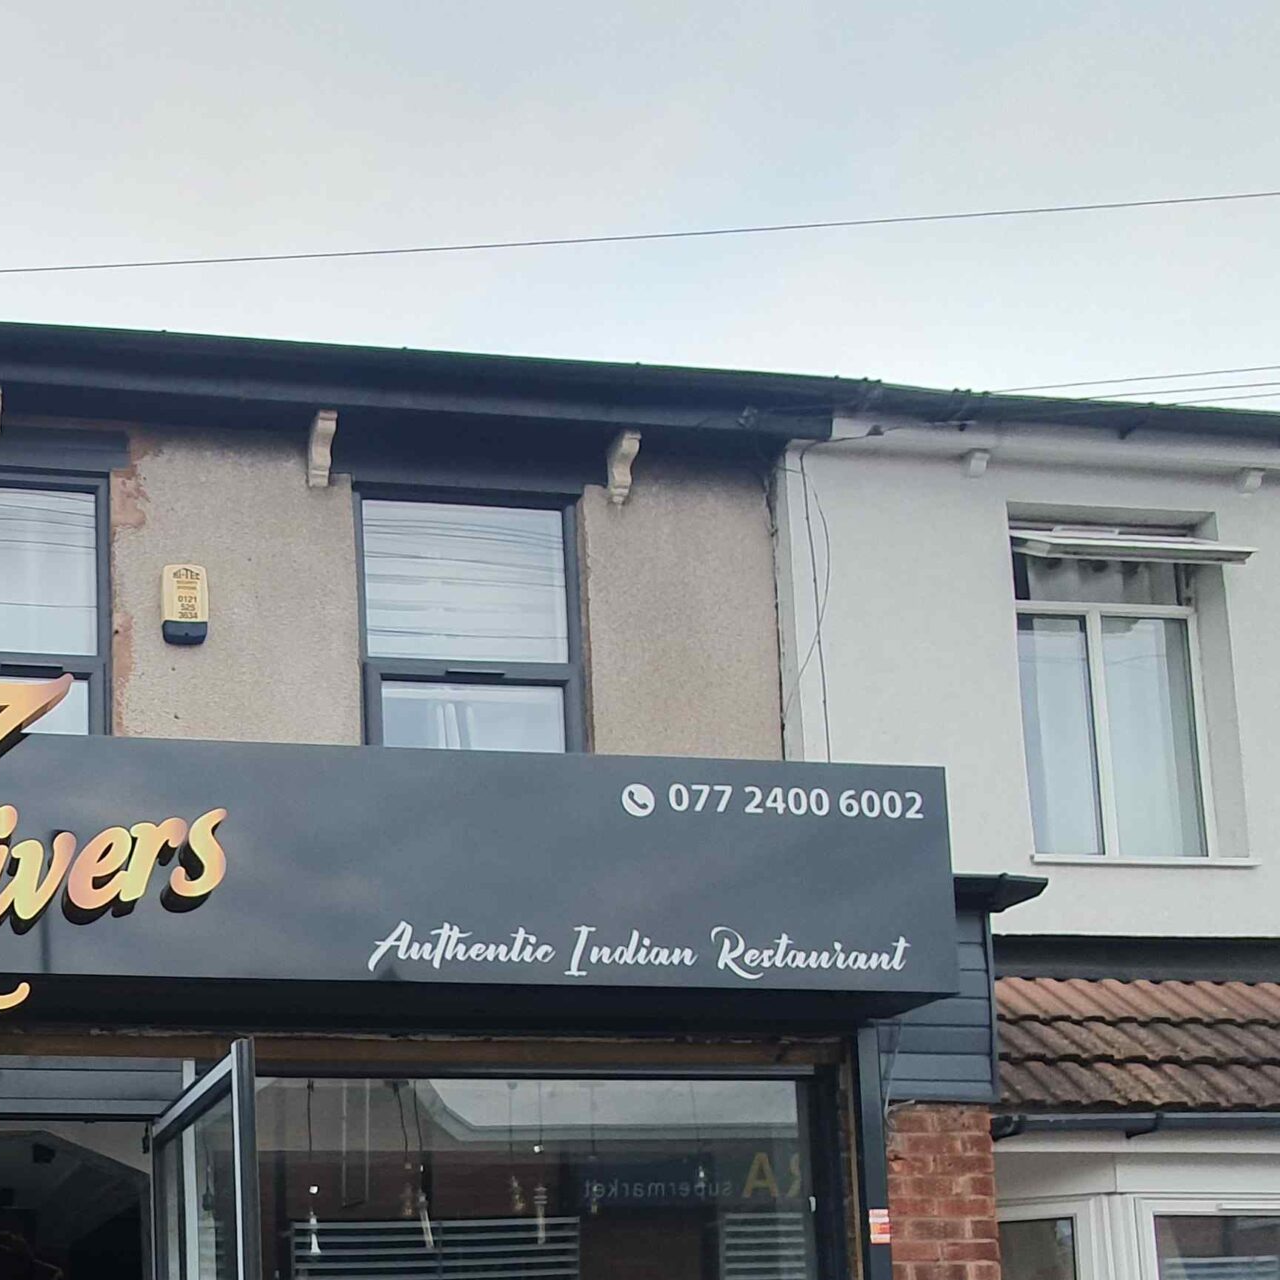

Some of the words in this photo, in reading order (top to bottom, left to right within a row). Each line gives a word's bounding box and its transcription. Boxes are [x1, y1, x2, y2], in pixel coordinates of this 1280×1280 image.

[177, 595, 197, 603] 0121
[668, 783, 733, 813] 077
[743, 786, 830, 817] 2400
[839, 789, 924, 819] 6002
[367, 920, 556, 972] Authentic
[563, 924, 699, 977] Indian
[710, 926, 912, 980] Restaurant
